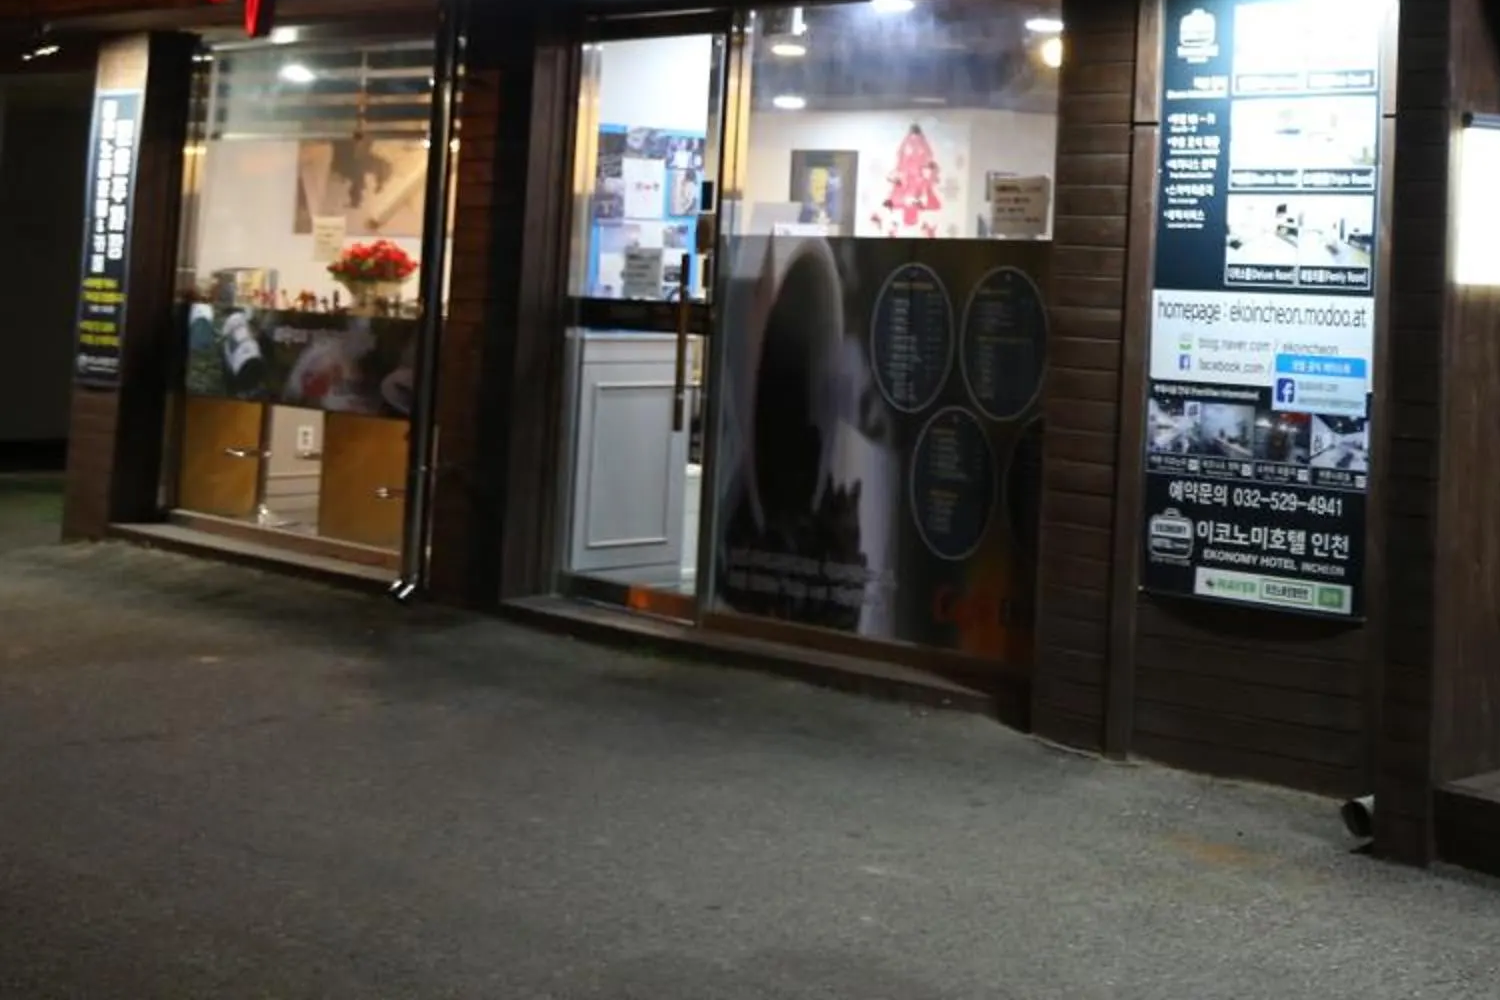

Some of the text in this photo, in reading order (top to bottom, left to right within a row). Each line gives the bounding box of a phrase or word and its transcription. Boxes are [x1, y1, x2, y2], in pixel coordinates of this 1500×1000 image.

[1158, 296, 1221, 324] homepage
[1169, 480, 1343, 517] 예약문의 032-529-4941
[1197, 520, 1350, 560] 이코노미호텔 인천
[1203, 548, 1258, 566] EKONOMY
[1259, 556, 1297, 571] HOTEL
